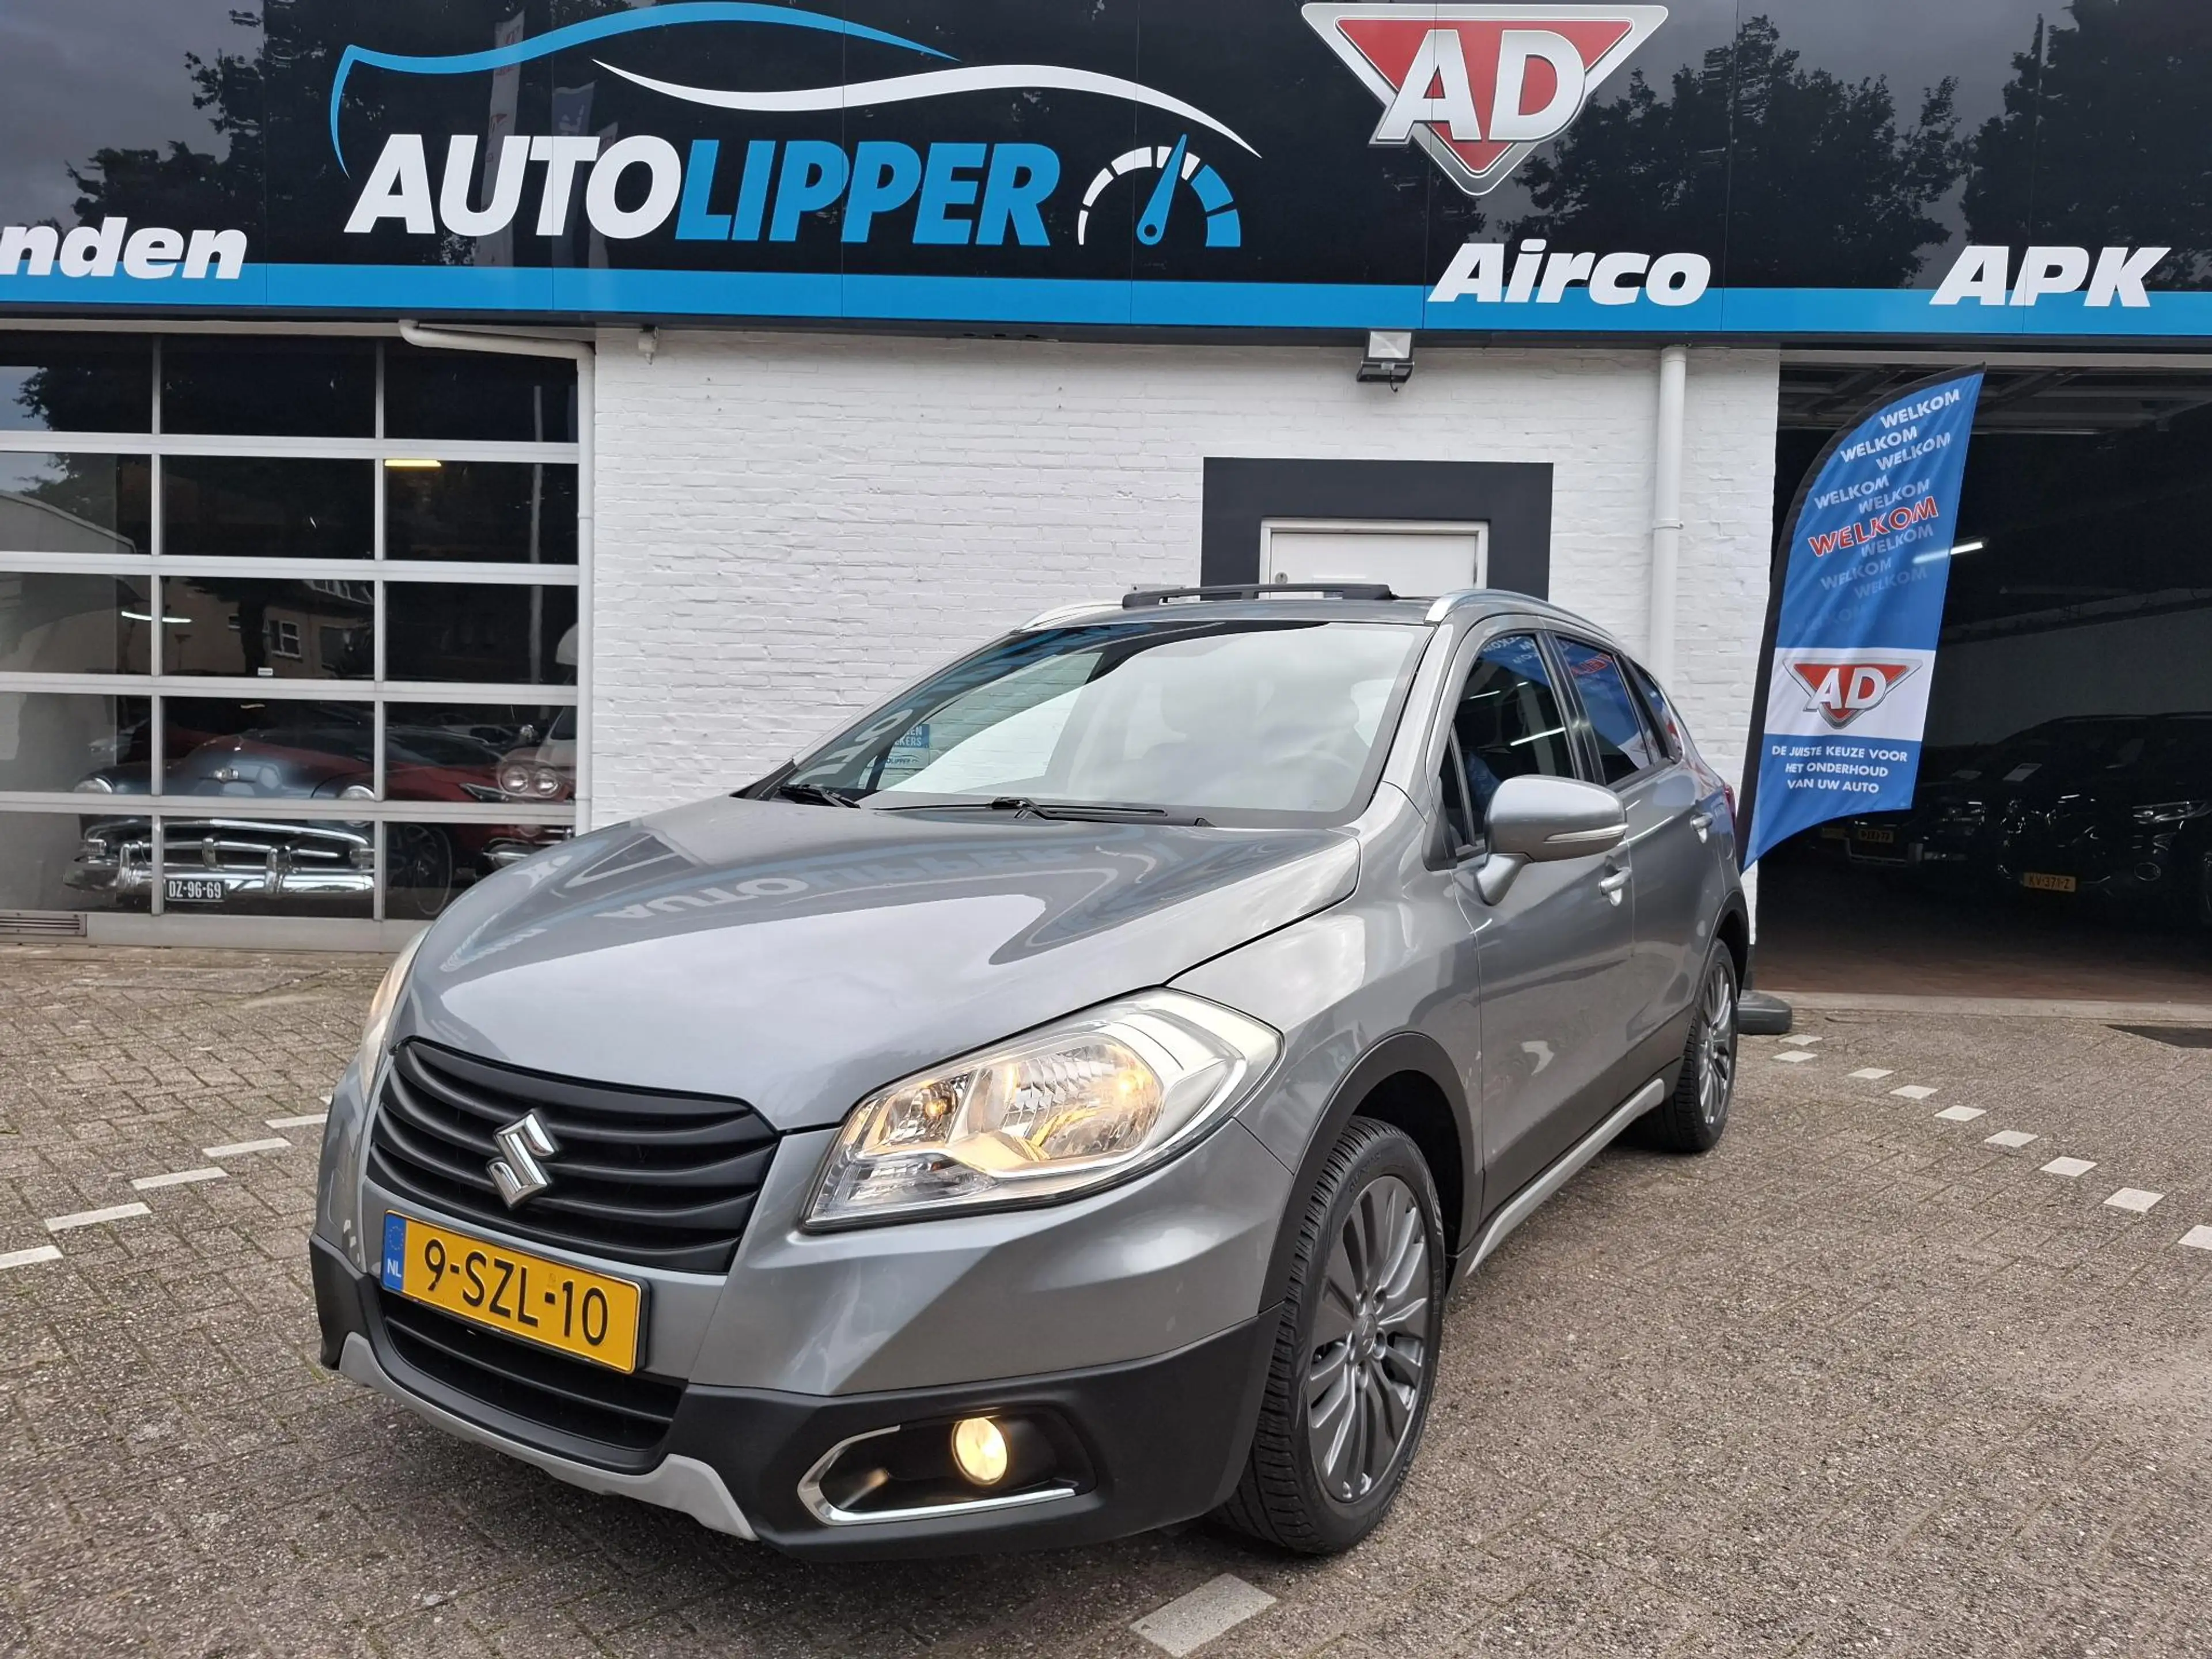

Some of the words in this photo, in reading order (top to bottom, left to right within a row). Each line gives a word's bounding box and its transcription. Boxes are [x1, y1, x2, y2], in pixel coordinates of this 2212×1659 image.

[1371, 28, 1585, 143] AD
[343, 134, 1061, 247] AUTOLIPPER
[1427, 238, 1711, 306] Airco
[1929, 245, 2172, 308] APK
[1880, 388, 1960, 429] WELKOM
[1840, 426, 1918, 463] WELKOM
[1876, 432, 1951, 471] WELKOM
[1814, 474, 1890, 510] WELKOM
[1858, 478, 1930, 514] WELKOM
[1808, 495, 1939, 557] WELKOM
[1861, 523, 1934, 558] WELKOM
[1820, 558, 1892, 591] WELKOM
[1853, 566, 1928, 600] WELKOM
[1805, 666, 1887, 710] AD
[1771, 745, 1787, 756] DE
[1789, 746, 1822, 757] JUISTE
[1826, 746, 1865, 758] KEUZE
[1869, 749, 1907, 762] VOOR
[1785, 763, 1804, 773] HET
[1806, 762, 1888, 777] ONDERHOUD
[1787, 778, 1814, 789] VAN
[1817, 779, 1840, 790] UW
[1842, 781, 1879, 793] AUTO
[387, 1257, 402, 1278] NL
[424, 1237, 608, 1346] 9-SZL-10
